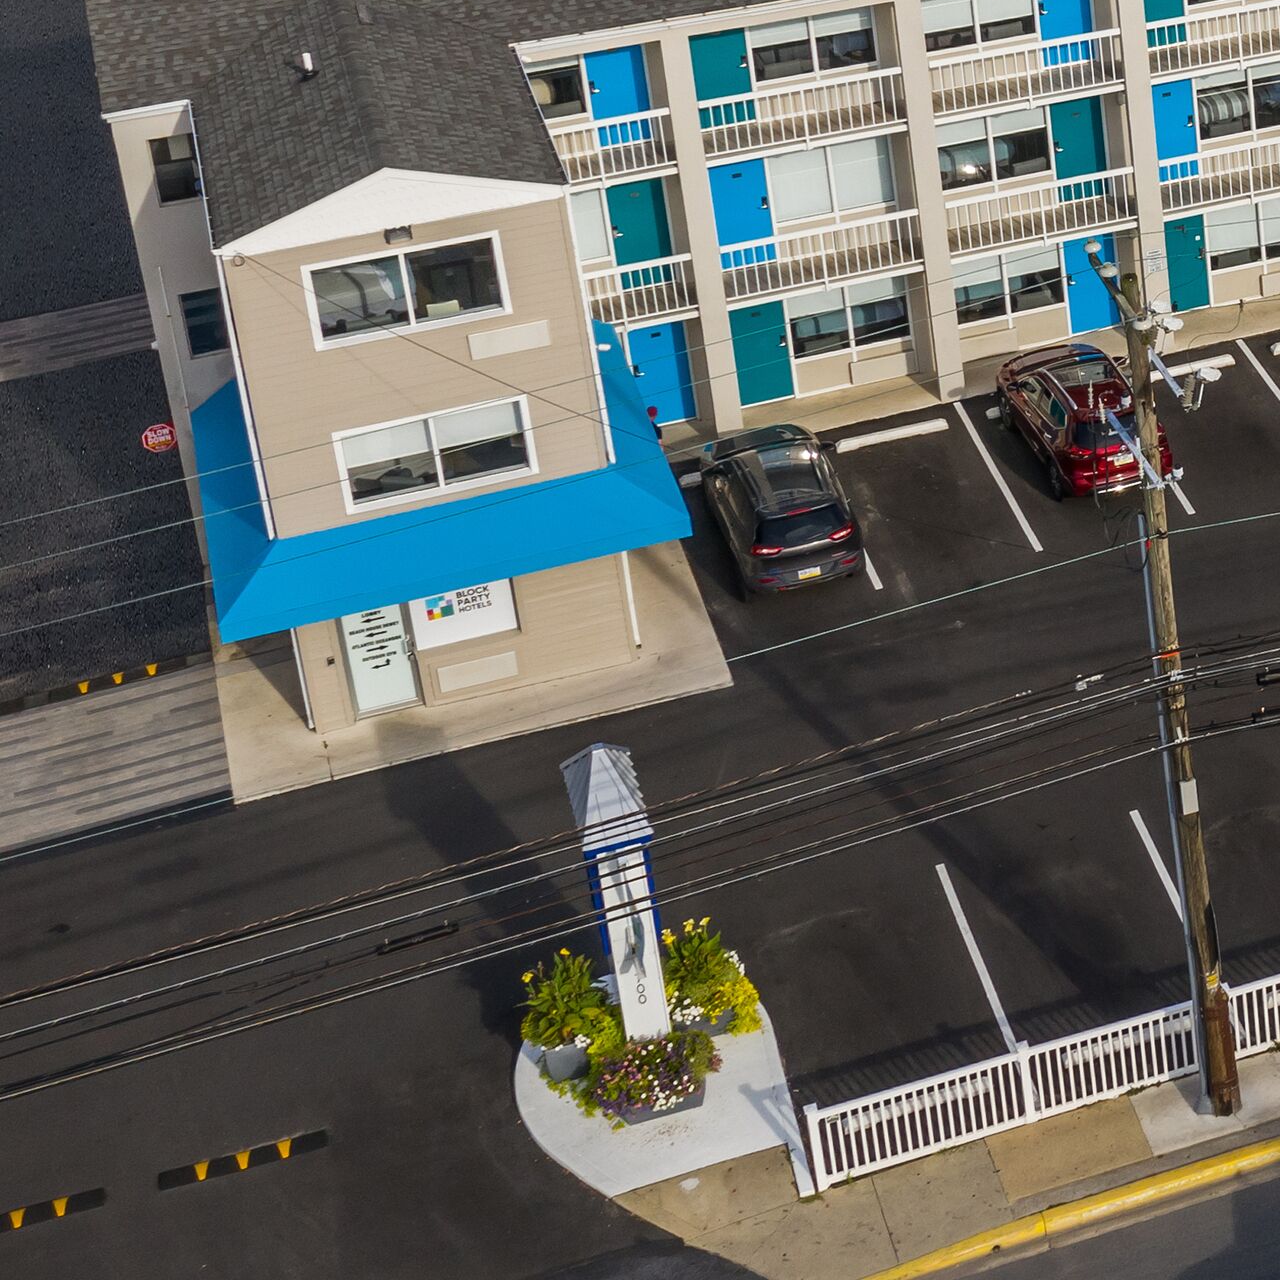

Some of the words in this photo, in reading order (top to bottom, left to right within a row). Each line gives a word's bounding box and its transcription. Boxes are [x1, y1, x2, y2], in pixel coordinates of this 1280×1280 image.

[148, 429, 170, 437] SLOW
[148, 435, 172, 444] DOWN
[456, 585, 489, 598] BLOCK
[458, 593, 490, 606] PARTY
[459, 600, 492, 613] HOTELS
[361, 610, 381, 618] LOBBY
[383, 620, 399, 628] DEWEY
[352, 641, 375, 650] ATLANTIC
